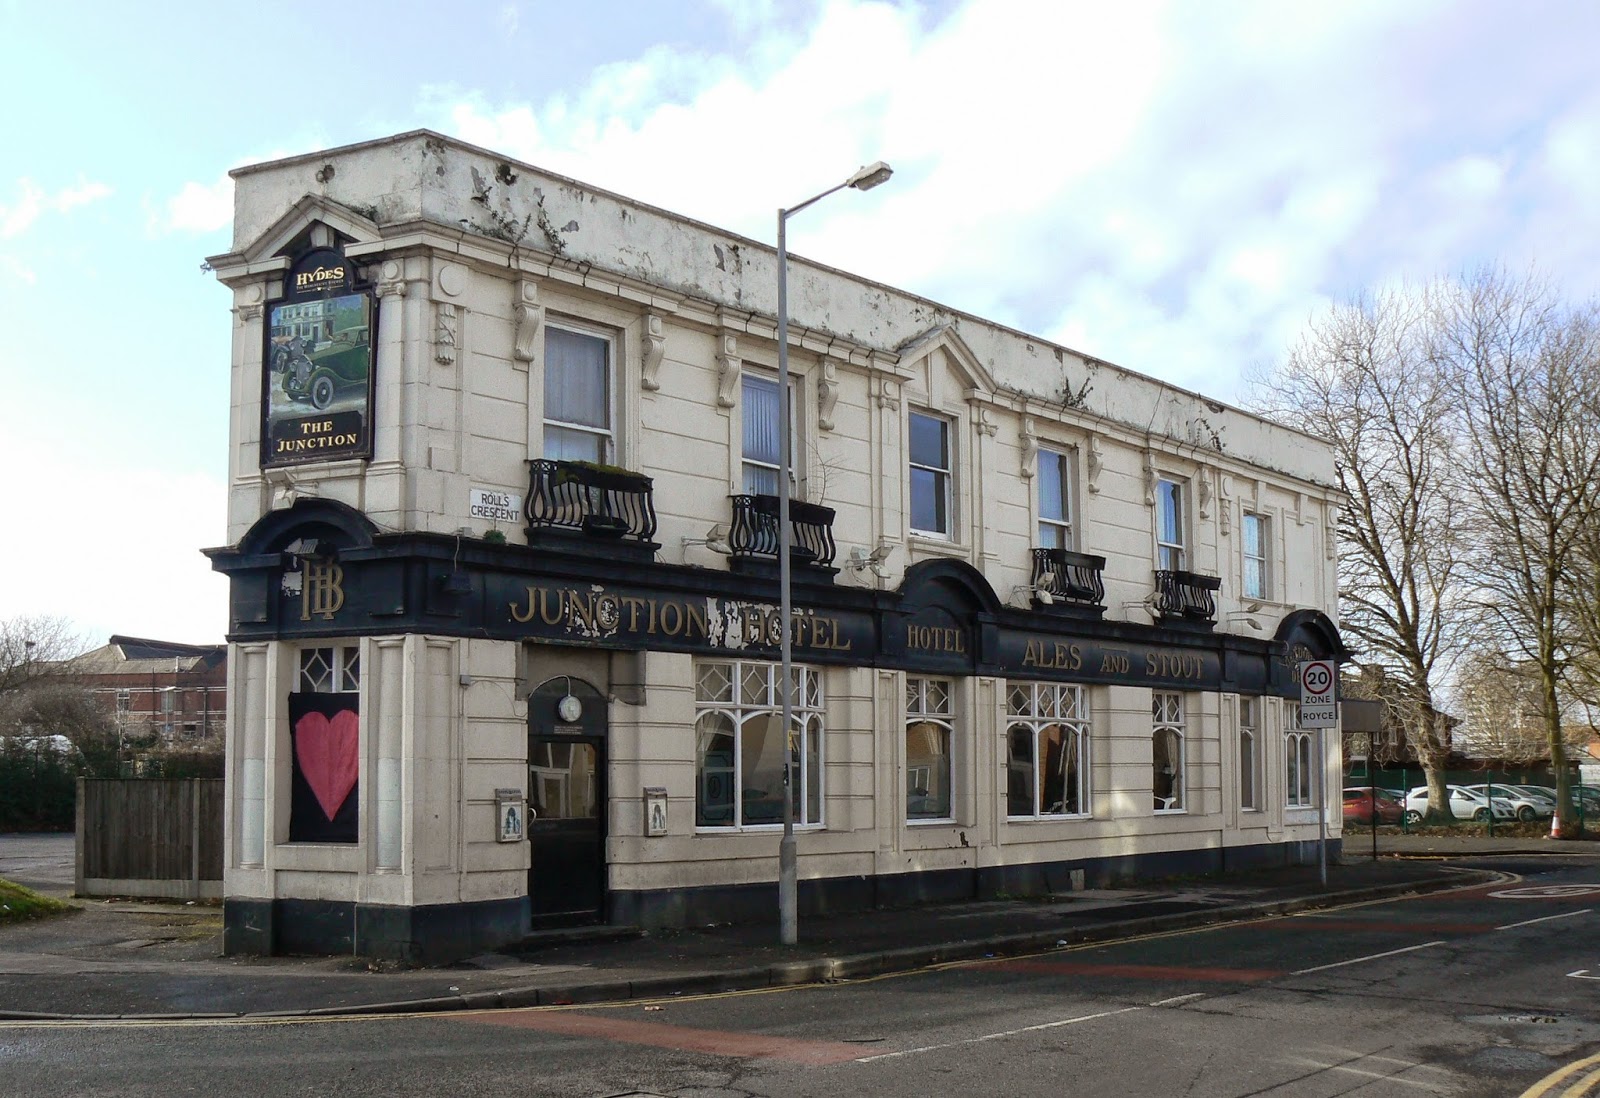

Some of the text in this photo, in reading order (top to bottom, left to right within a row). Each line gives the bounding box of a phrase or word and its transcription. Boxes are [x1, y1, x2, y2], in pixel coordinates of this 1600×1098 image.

[297, 266, 344, 285] HYDES
[301, 420, 333, 434] THE
[277, 433, 357, 452] JUNCTION
[482, 494, 509, 506] ROLLS
[471, 505, 519, 520] CRESCENT
[508, 586, 851, 650] JUNCTION HOTEL
[907, 625, 965, 653] HOTEL
[1022, 639, 1204, 680] ALES AND STOUT
[1308, 671, 1327, 684] 20
[1303, 712, 1333, 720] ROYCE
